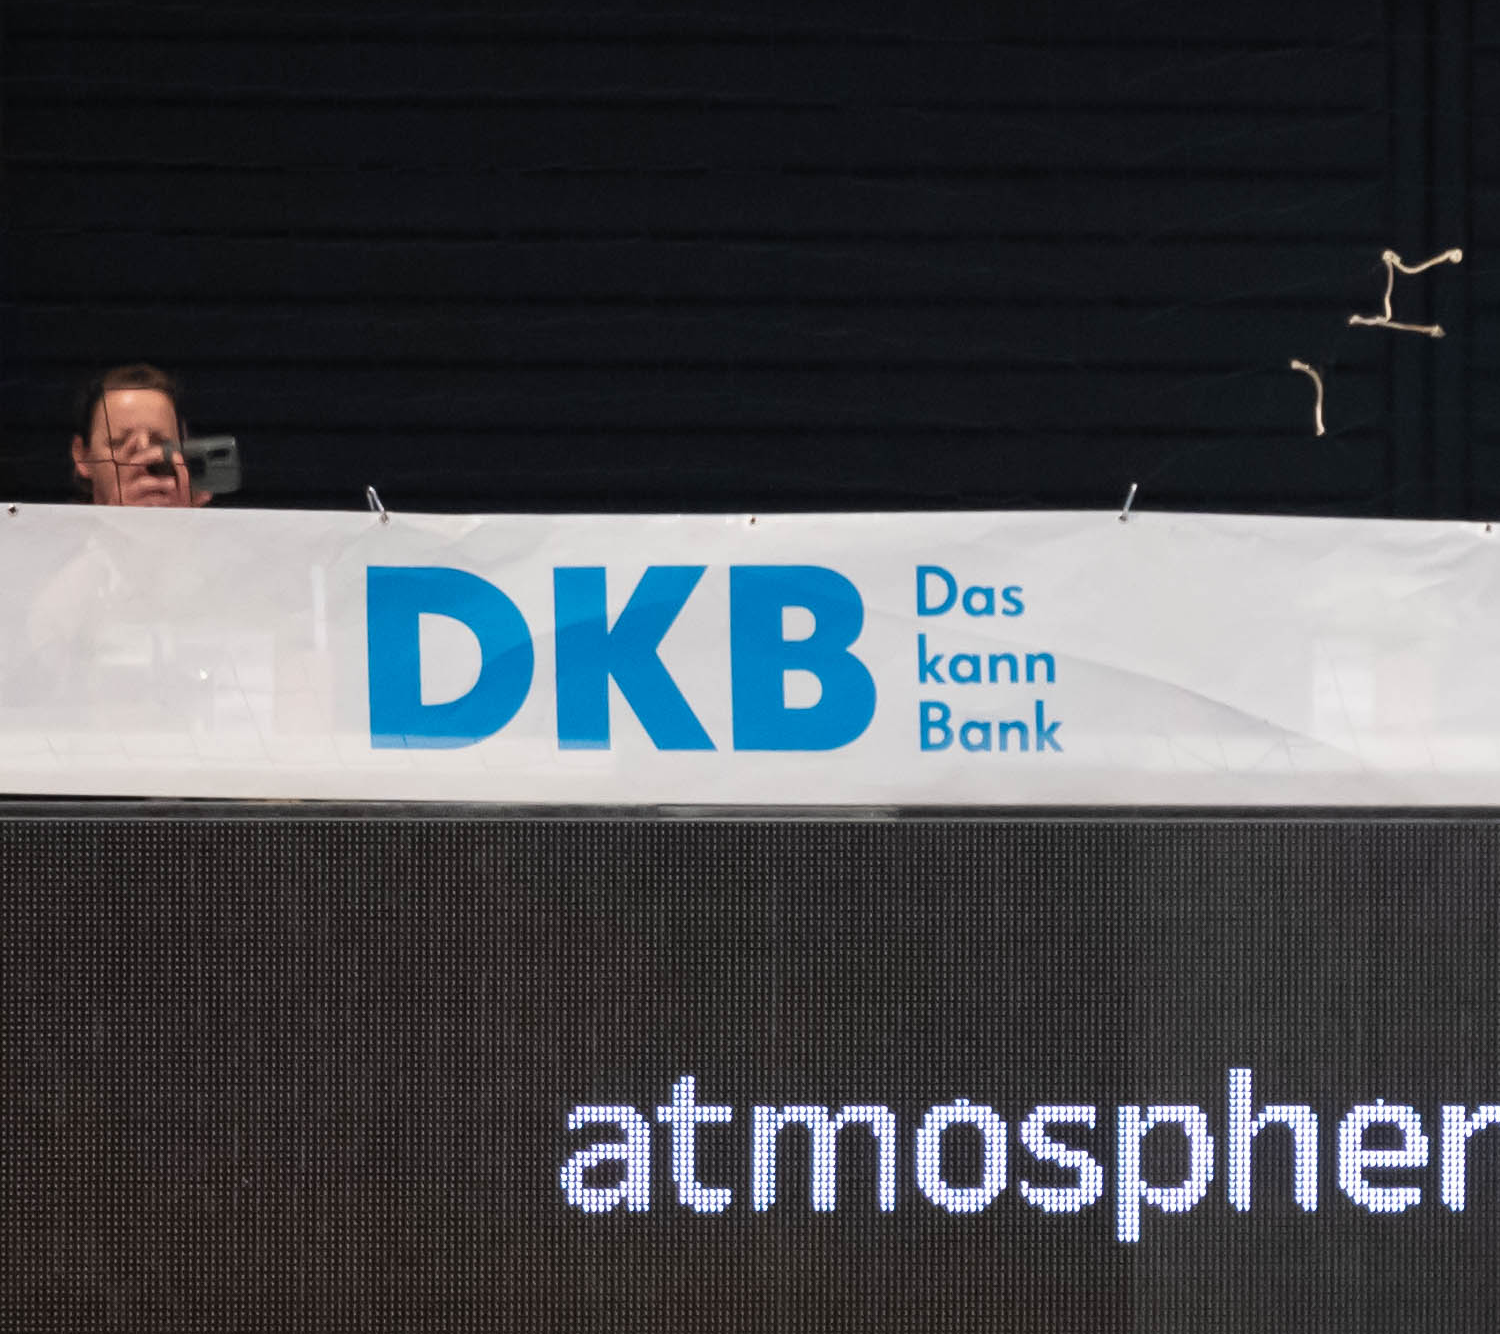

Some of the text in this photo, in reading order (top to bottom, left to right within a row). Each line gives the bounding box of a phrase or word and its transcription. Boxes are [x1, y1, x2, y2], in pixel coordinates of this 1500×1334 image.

[916, 566, 1024, 618] Das
[366, 565, 878, 752] DKB
[917, 634, 1057, 685] kann
[919, 700, 1063, 753] Bank
